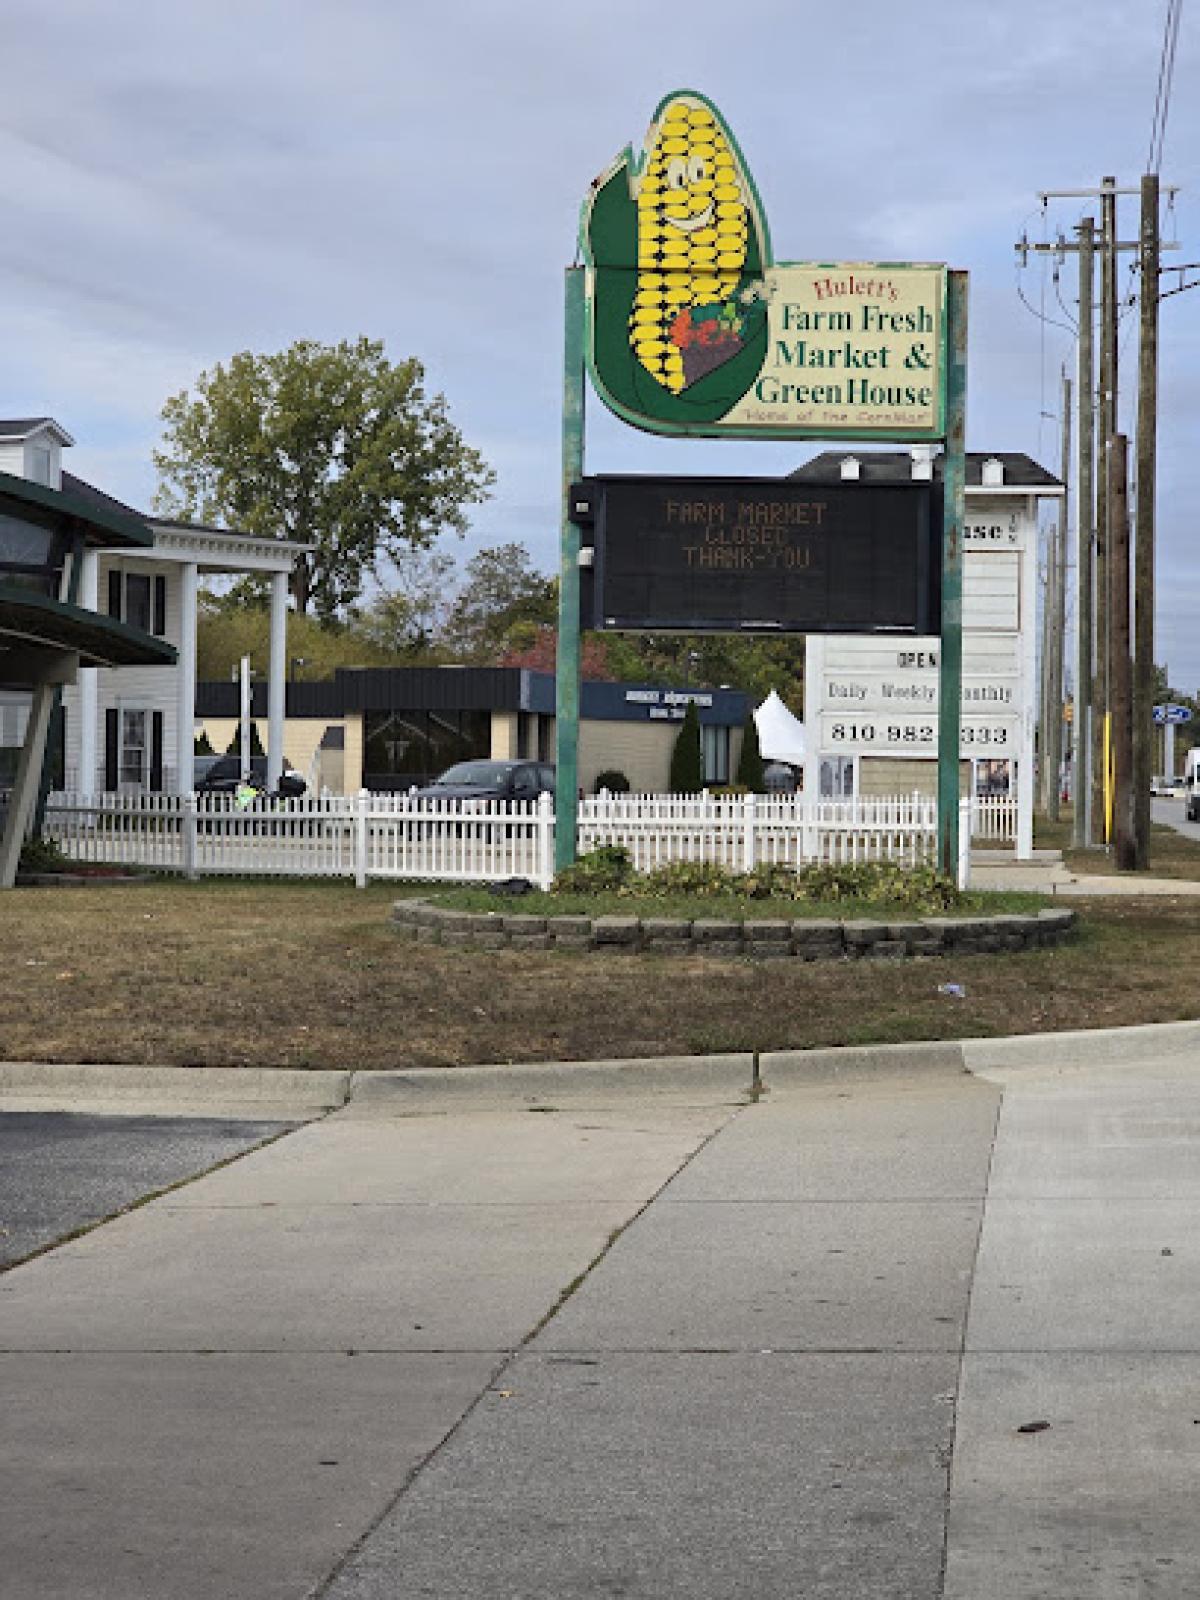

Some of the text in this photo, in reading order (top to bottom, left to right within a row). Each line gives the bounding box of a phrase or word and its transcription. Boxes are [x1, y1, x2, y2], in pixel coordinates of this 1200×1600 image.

[782, 304, 934, 333] Farm Fresh
[773, 340, 934, 370] Market &
[666, 499, 827, 525] FARM MARKET
[705, 525, 787, 545] CLOSED
[898, 652, 937, 668] OPEN
[828, 682, 1013, 704] Daily Weekly onthly
